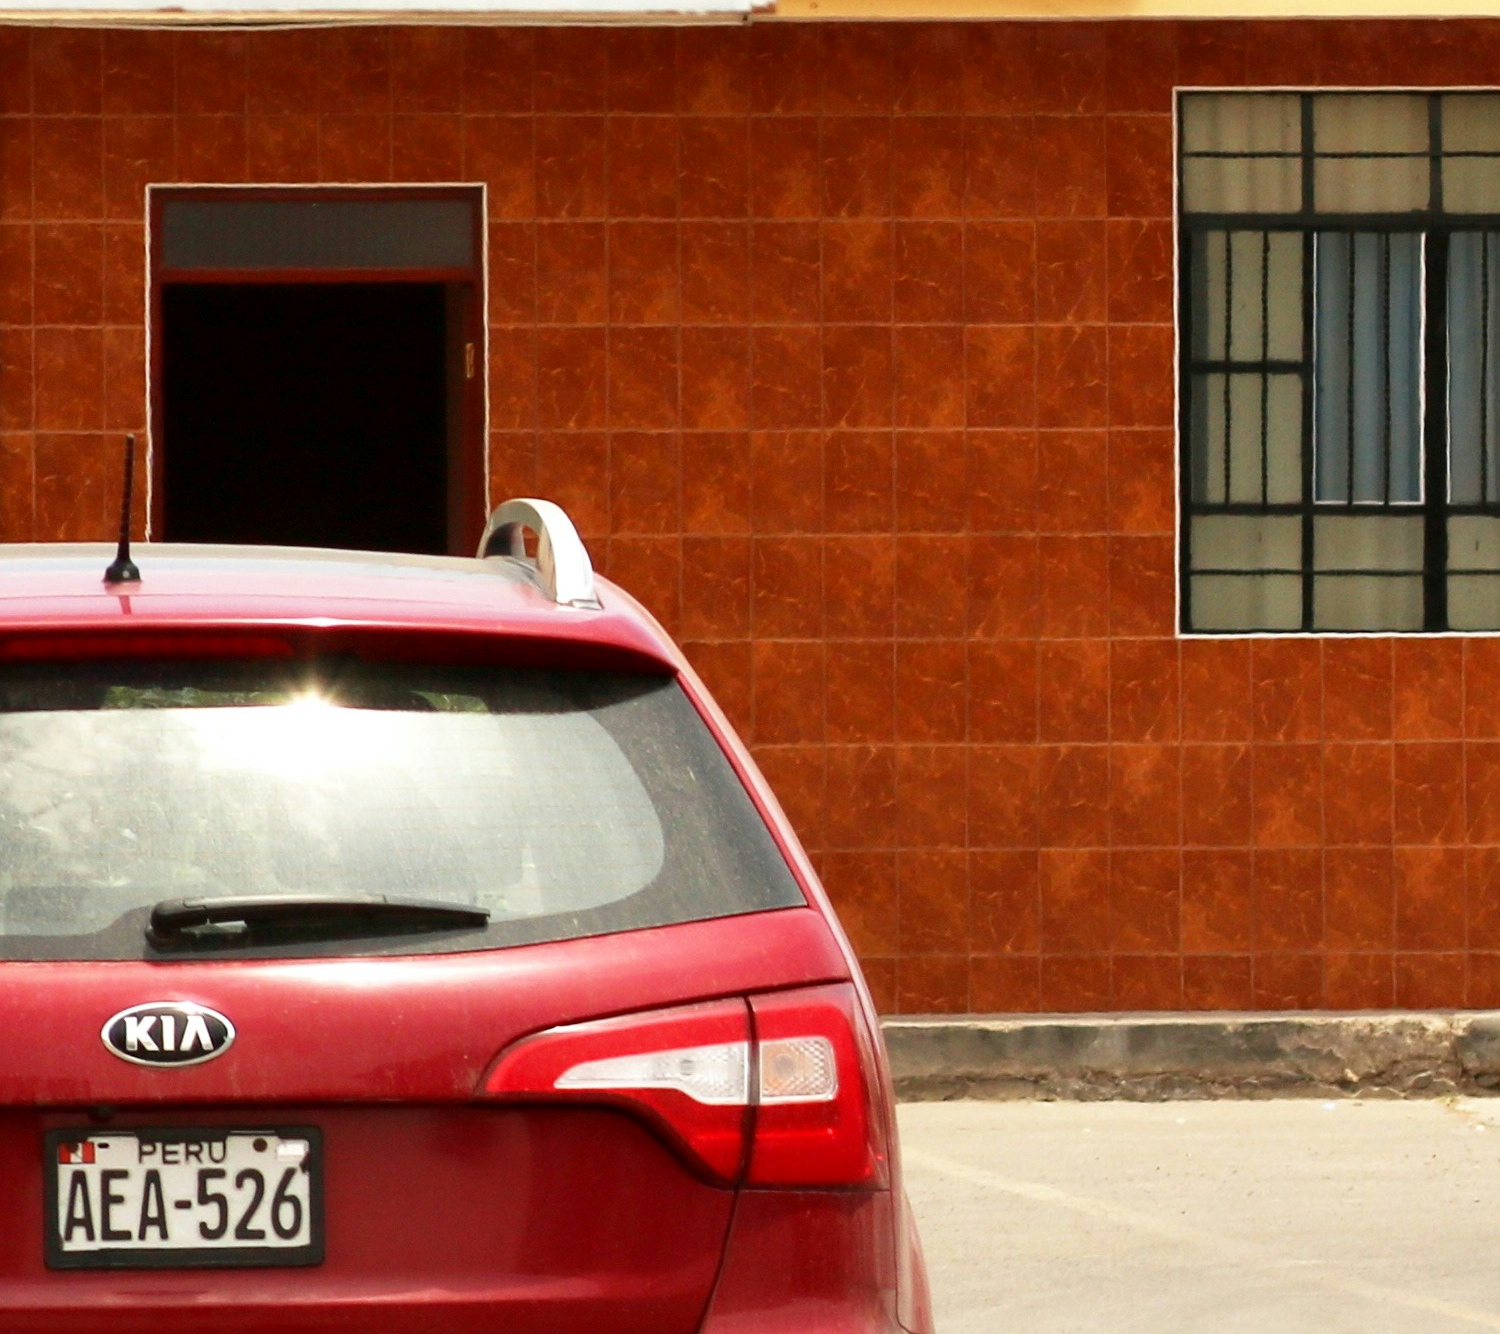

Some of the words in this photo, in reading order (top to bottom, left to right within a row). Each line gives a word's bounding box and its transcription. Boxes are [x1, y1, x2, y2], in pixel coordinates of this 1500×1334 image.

[123, 1014, 215, 1052] KIA
[137, 1140, 228, 1165] PERU
[64, 1167, 303, 1242] AEA-526
